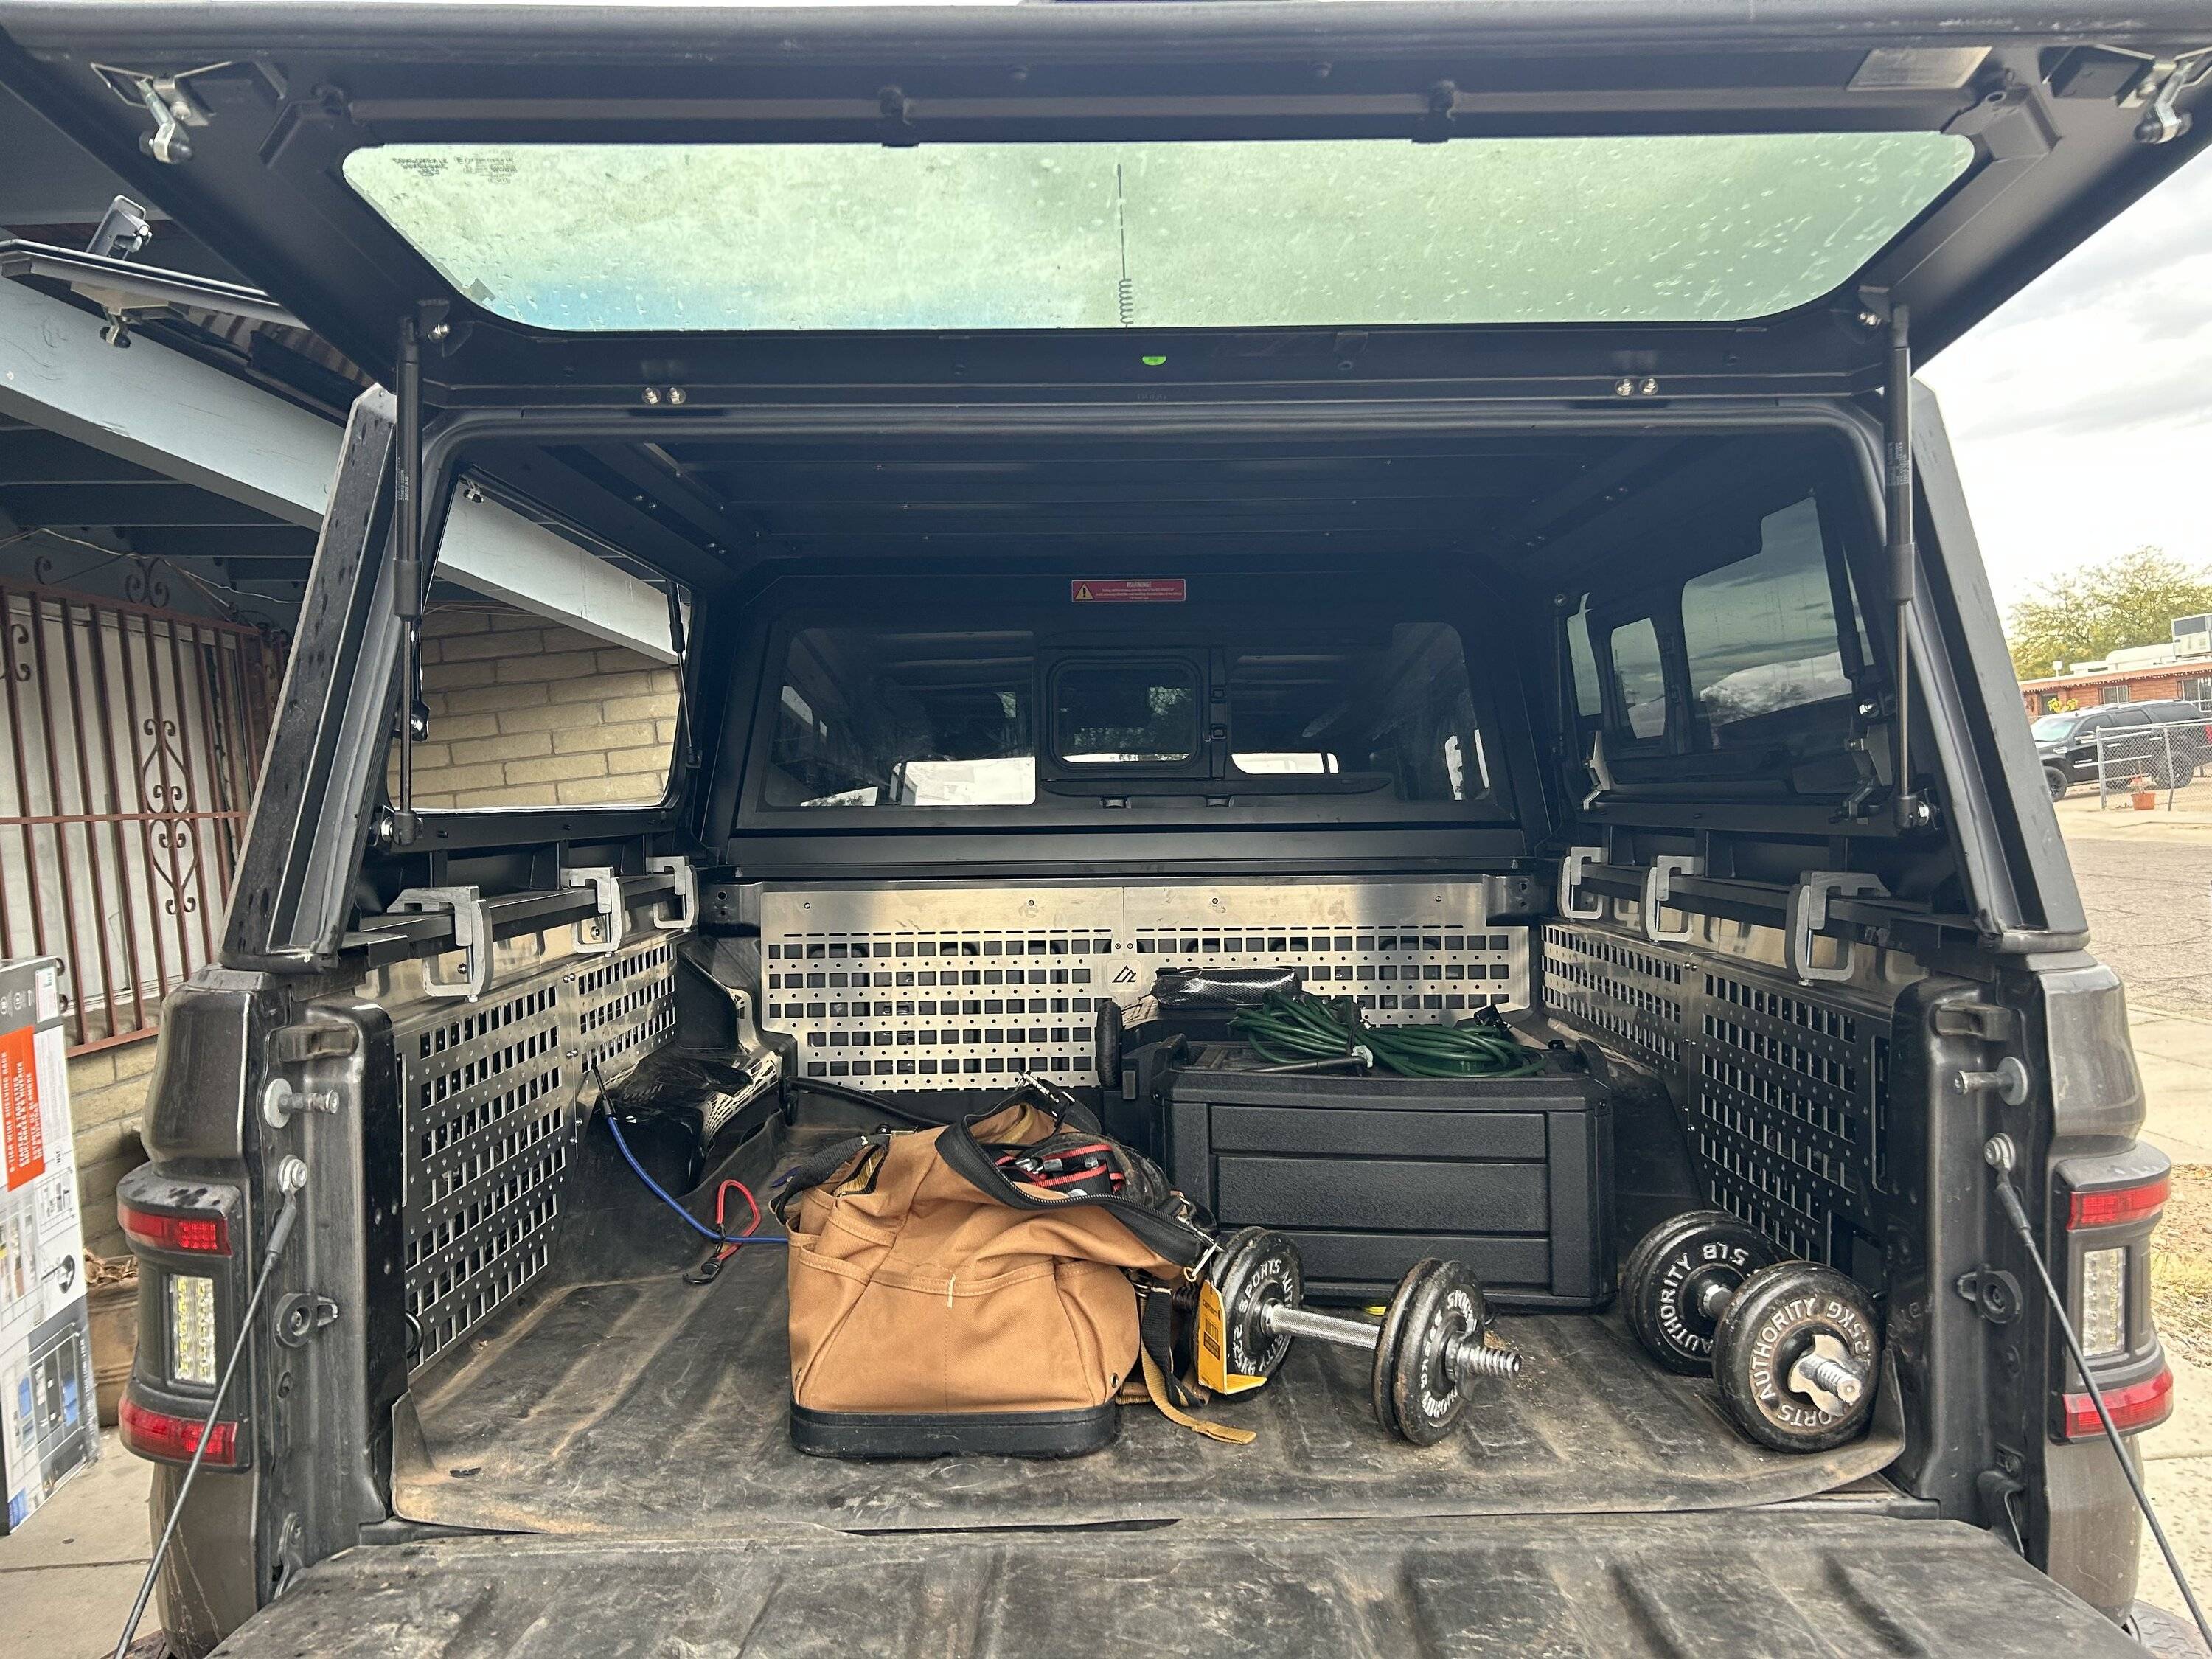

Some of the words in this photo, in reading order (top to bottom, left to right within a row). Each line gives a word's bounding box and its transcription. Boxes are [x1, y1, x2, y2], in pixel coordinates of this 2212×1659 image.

[1239, 1259, 1281, 1313] SPORTS
[1703, 1242, 1749, 1266] 5LB
[1259, 1270, 1293, 1372] AUTRITY
[1660, 1253, 1714, 1354] AUTHORITY
[1750, 1295, 1818, 1400] AUTHORITY
[1777, 1404, 1832, 1427] ORTS
